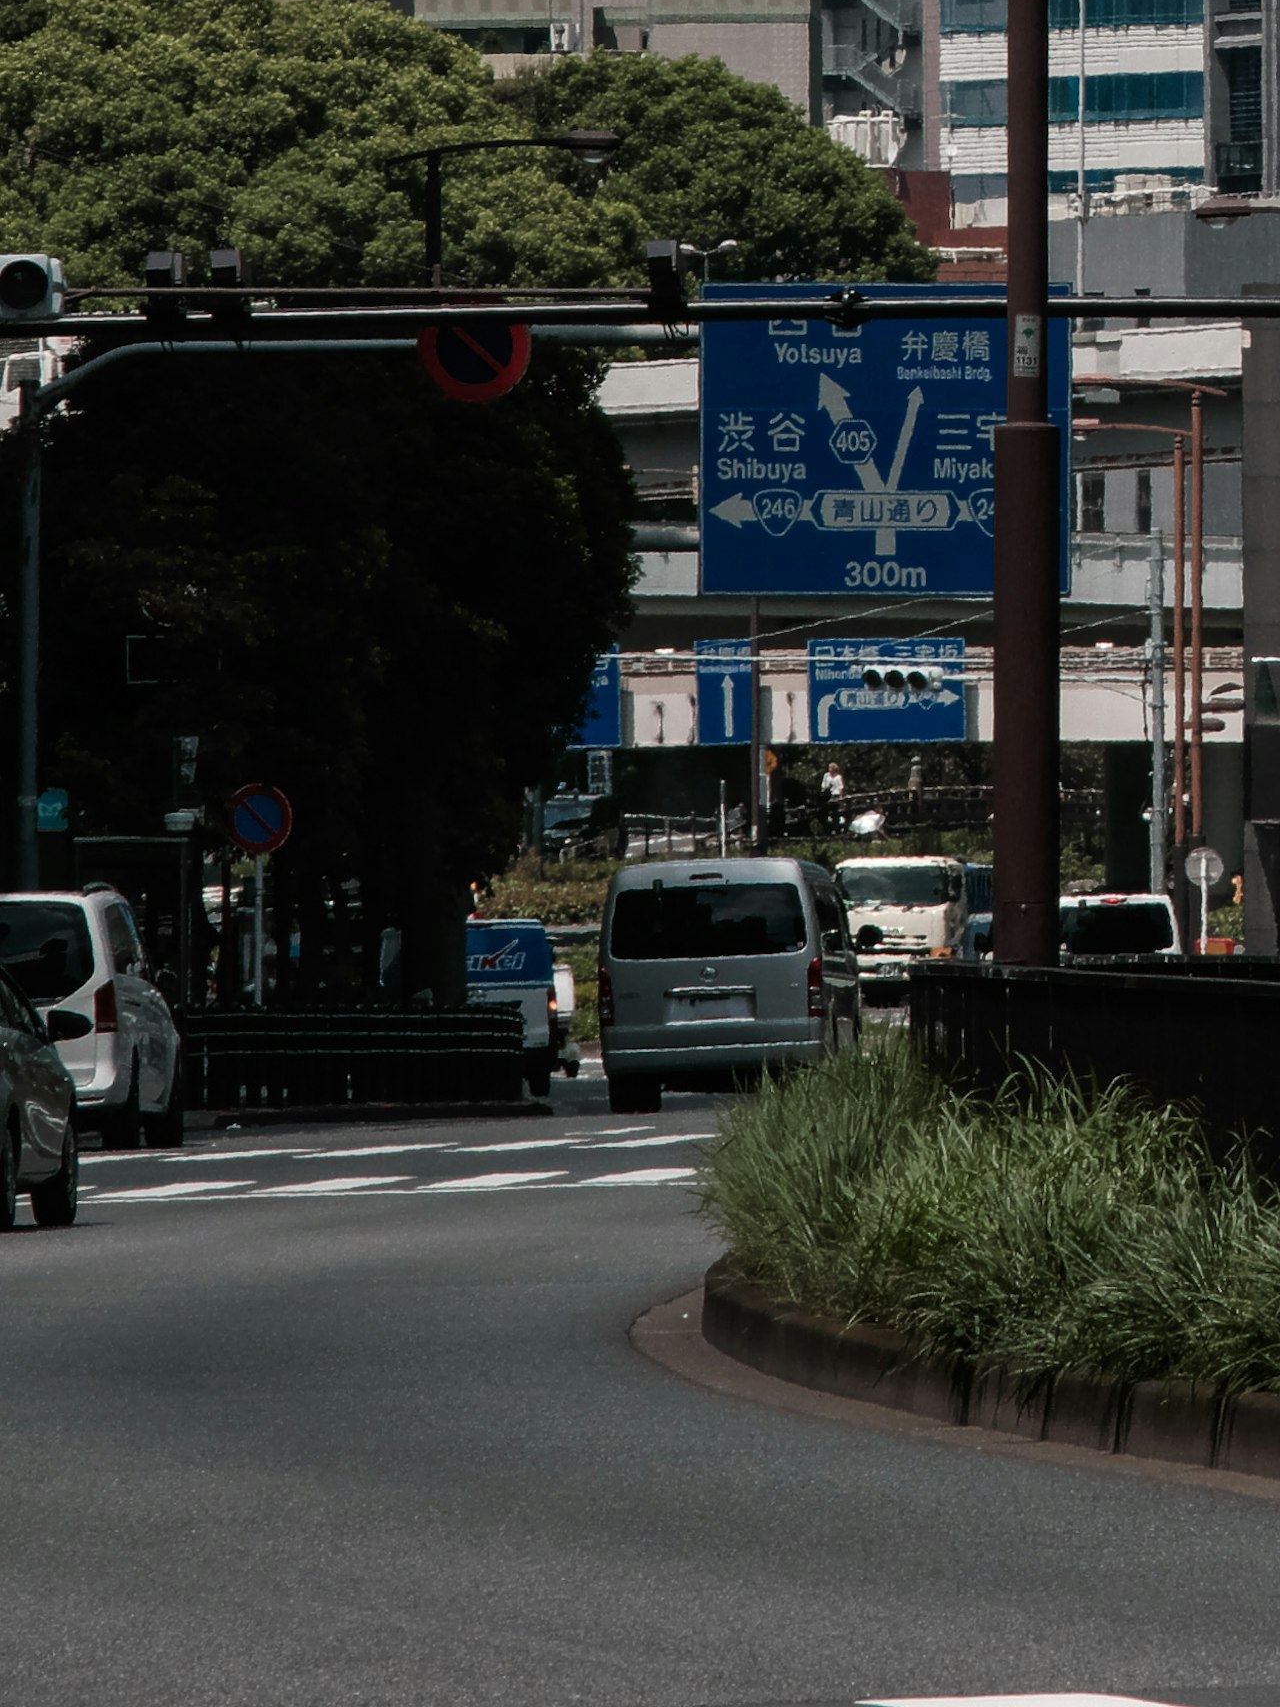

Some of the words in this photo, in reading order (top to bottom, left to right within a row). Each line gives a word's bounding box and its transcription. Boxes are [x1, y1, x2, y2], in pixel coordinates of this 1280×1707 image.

[774, 342, 862, 368] Yotsuya
[900, 329, 990, 362] 弁慶橋
[897, 365, 961, 380] Benkeibashi
[964, 365, 993, 383] Brdg.
[717, 411, 806, 452] 渋谷
[836, 430, 871, 452] 405
[936, 411, 1007, 452] 三宅
[716, 457, 807, 484] Shibuya
[934, 457, 995, 484] Miyak
[761, 498, 796, 519] 246
[832, 498, 938, 522] 青山通り
[844, 560, 927, 588] 300m
